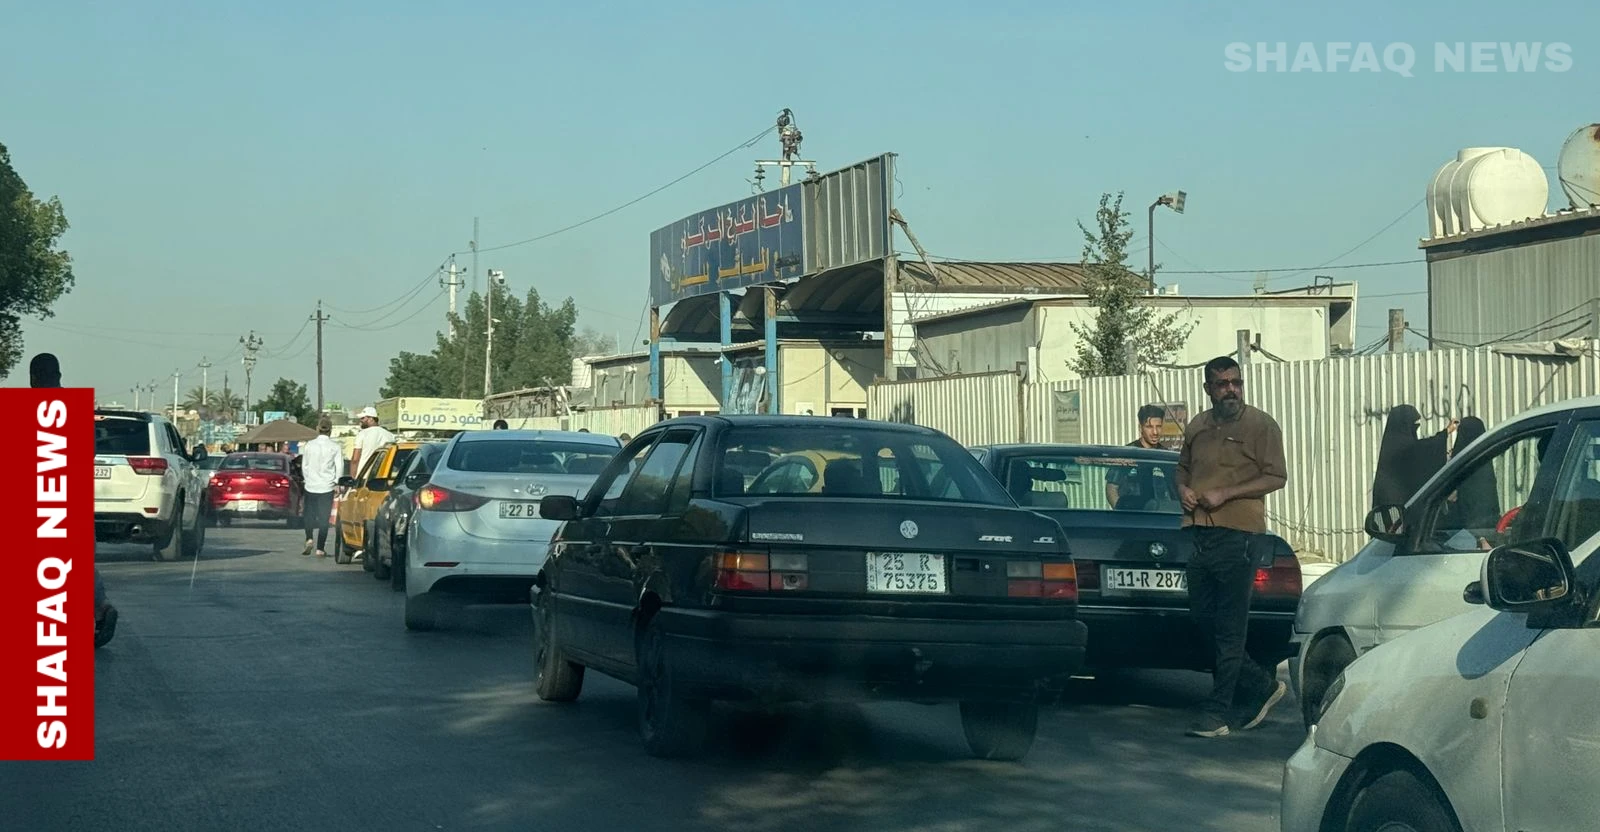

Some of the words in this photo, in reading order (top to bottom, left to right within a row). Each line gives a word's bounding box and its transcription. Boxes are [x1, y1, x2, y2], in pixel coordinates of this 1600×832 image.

[401, 410, 447, 426] مرورية
[508, 504, 523, 517] 22
[527, 504, 535, 517] B
[882, 553, 905, 571] 25
[919, 553, 931, 571] R
[883, 572, 939, 590] 75375
[1117, 571, 1135, 587] 11
[1140, 571, 1150, 588] R
